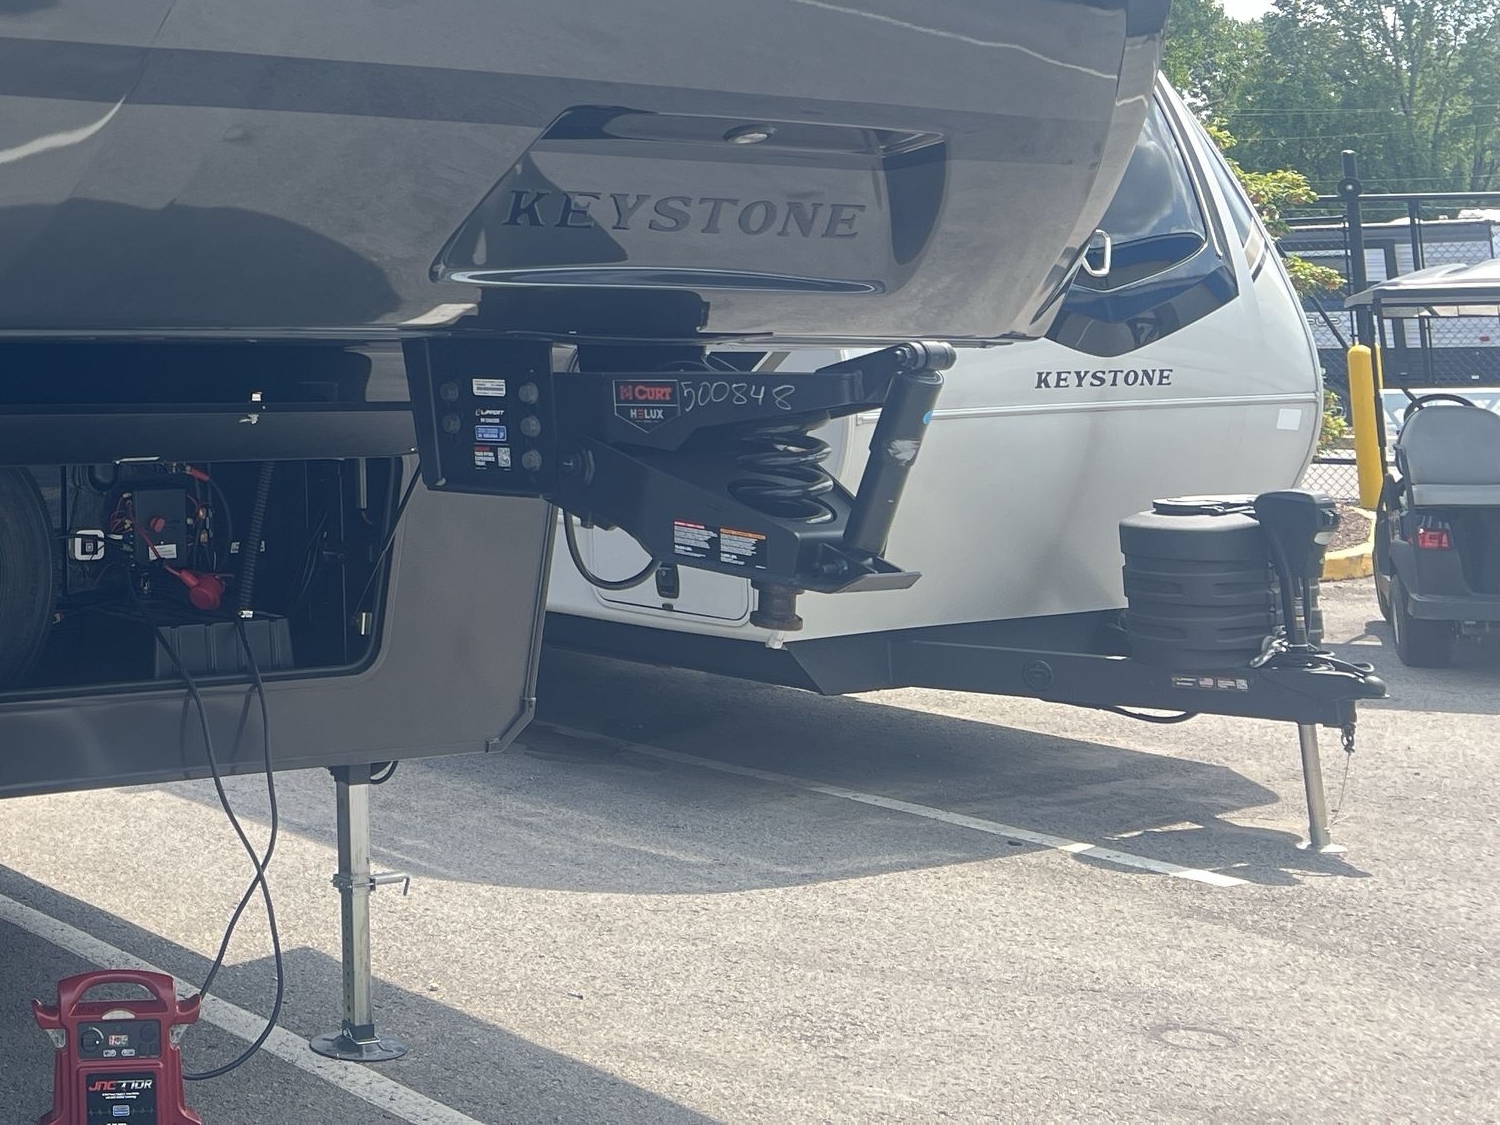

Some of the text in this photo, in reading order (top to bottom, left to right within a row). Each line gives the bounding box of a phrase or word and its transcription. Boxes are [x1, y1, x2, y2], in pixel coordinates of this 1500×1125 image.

[502, 189, 866, 239] KEYSTONE
[1034, 369, 1173, 389] KEYSTONE
[681, 381, 796, 412] 500848
